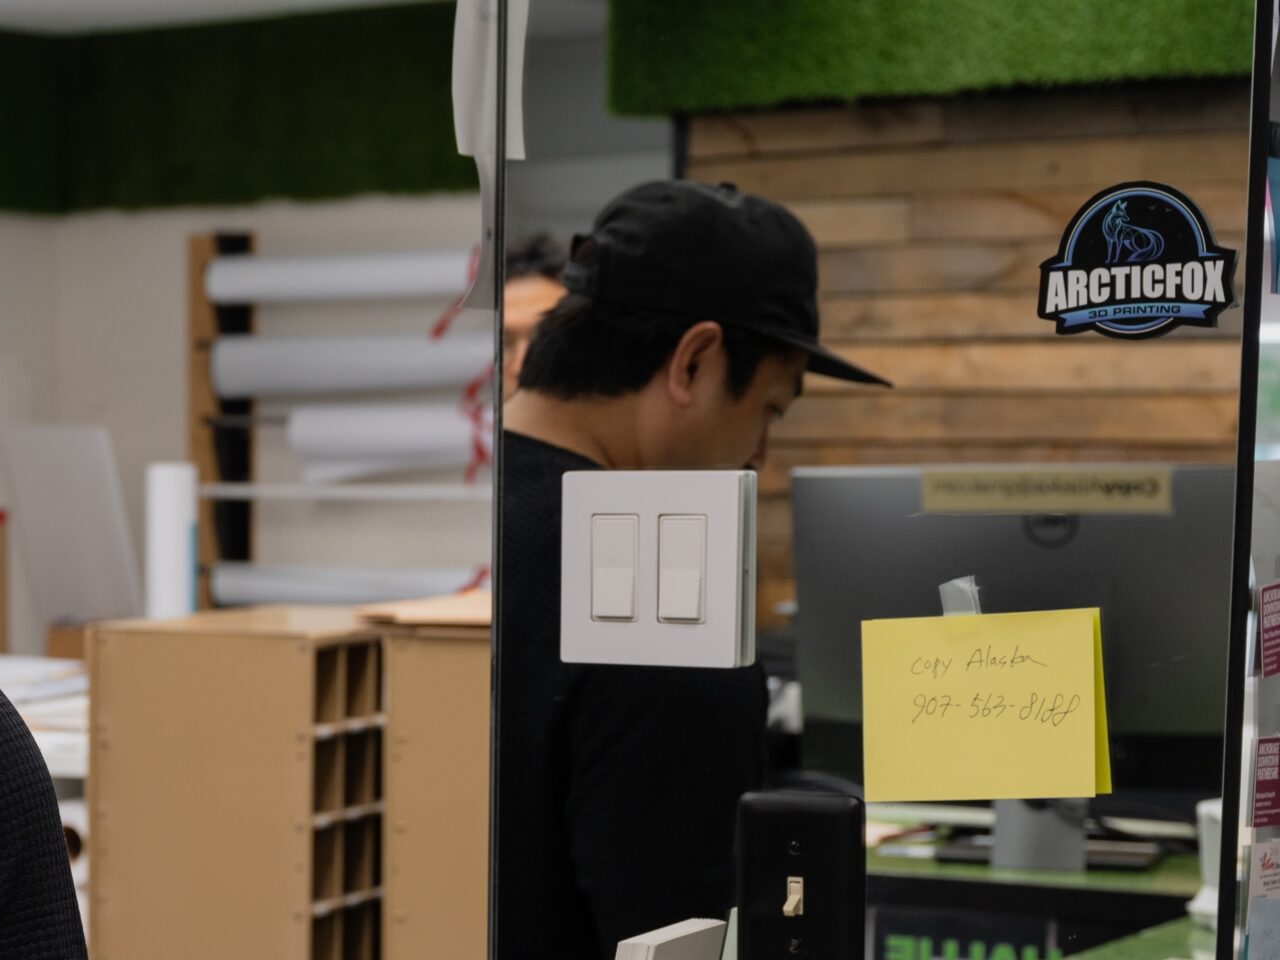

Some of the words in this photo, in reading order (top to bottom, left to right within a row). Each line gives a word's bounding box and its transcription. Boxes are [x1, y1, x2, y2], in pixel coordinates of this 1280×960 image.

[1044, 259, 1226, 315] ARCTICFOX
[1087, 307, 1110, 320] 3D
[1112, 303, 1182, 316] PRINTING
[965, 644, 1049, 671] Alaska
